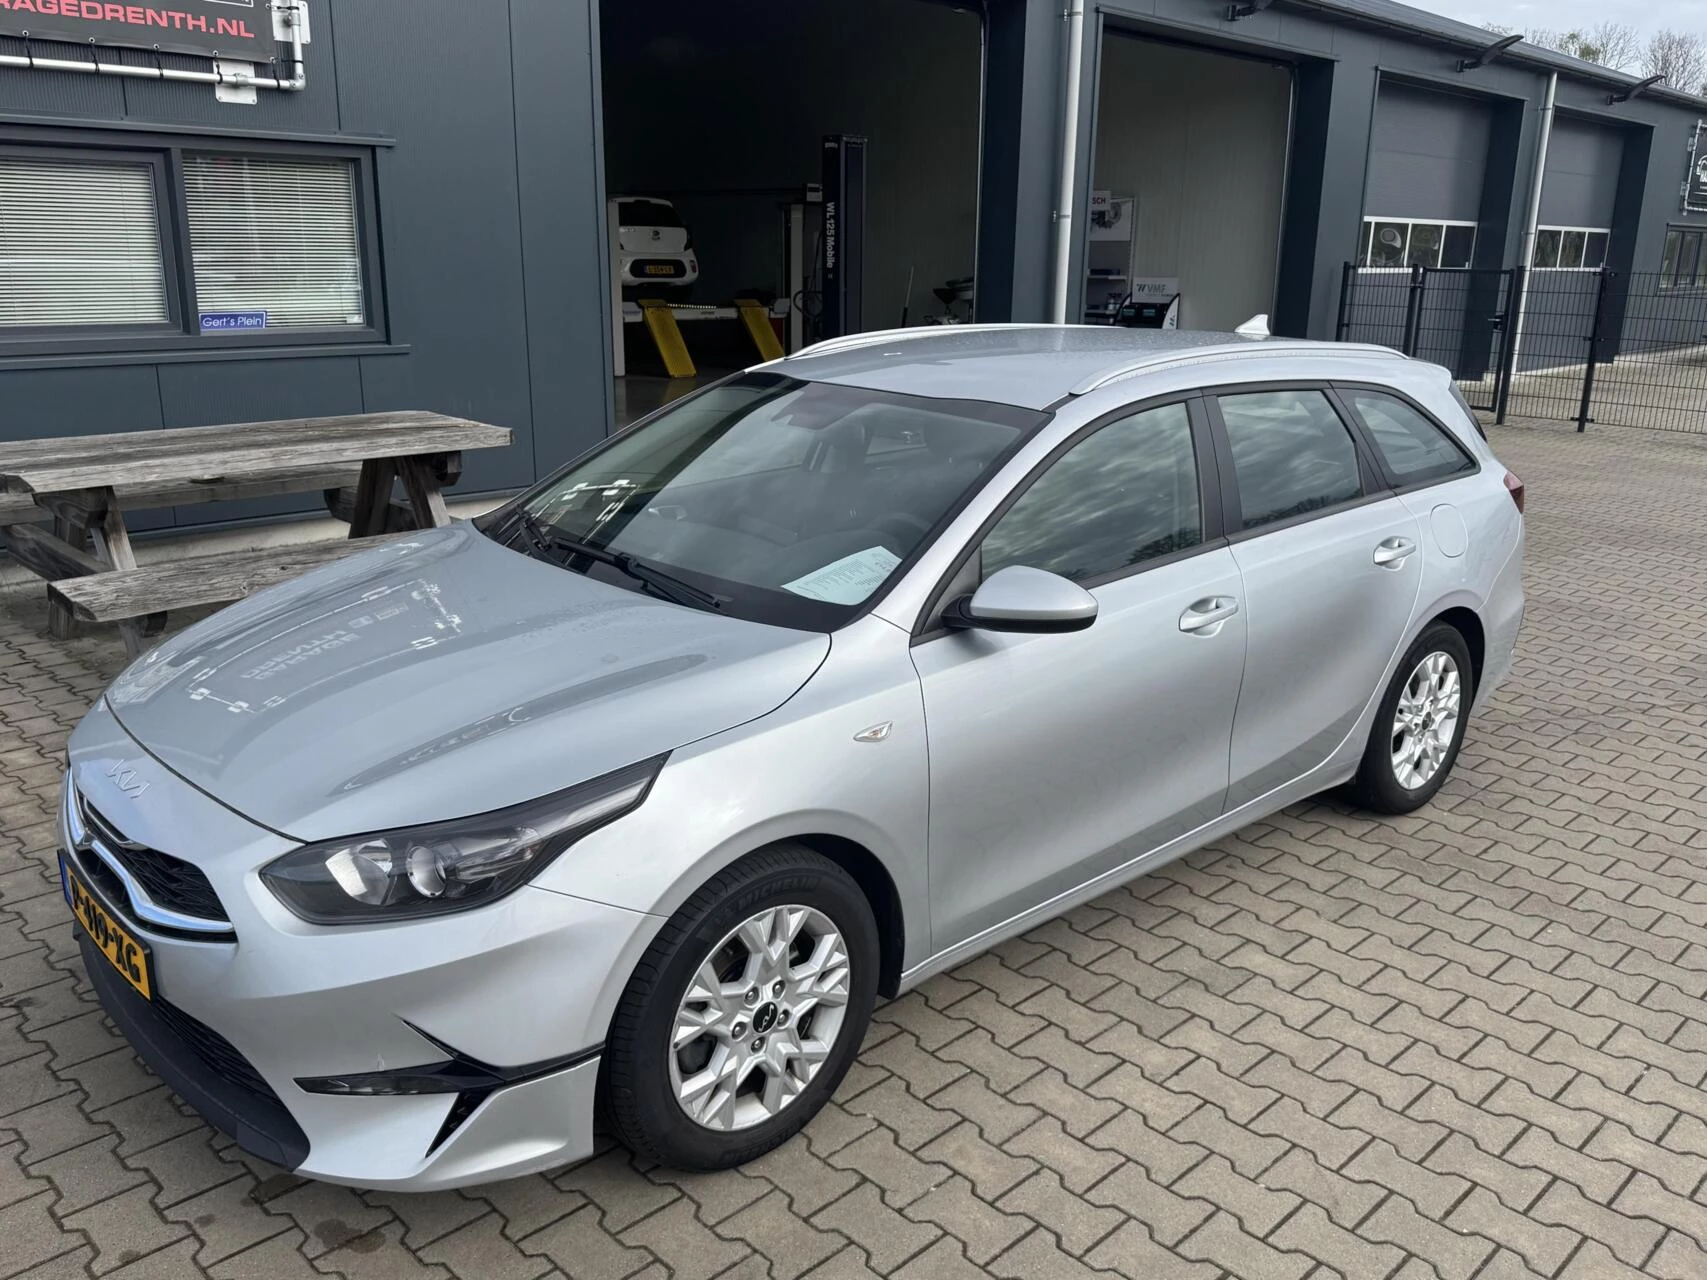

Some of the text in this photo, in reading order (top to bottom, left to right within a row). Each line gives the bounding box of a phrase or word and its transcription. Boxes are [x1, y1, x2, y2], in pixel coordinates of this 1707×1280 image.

[0, 0, 255, 38] AGEDRENTH.NL
[827, 236, 835, 269] Mobile
[237, 316, 262, 326] Plein
